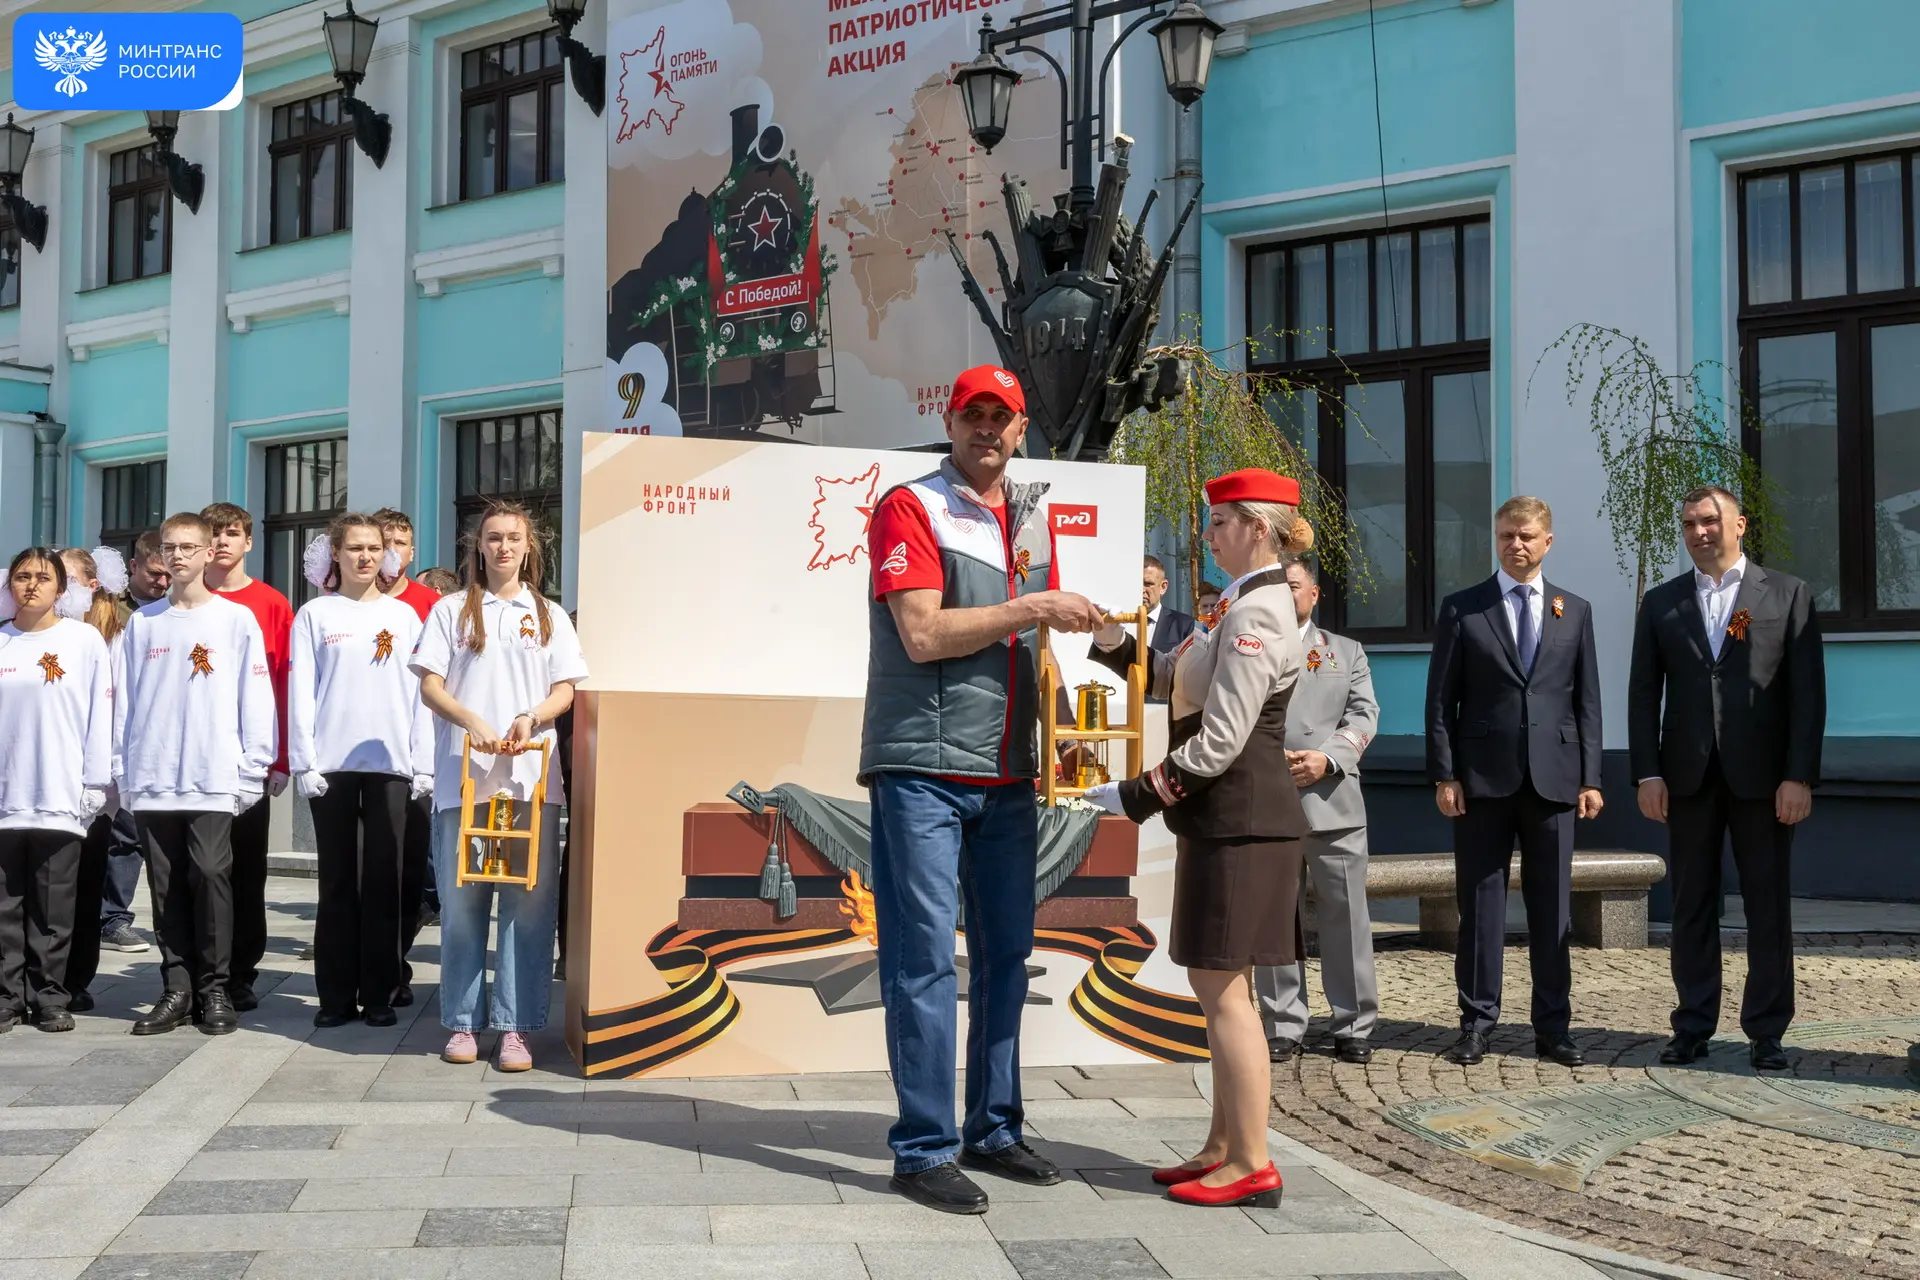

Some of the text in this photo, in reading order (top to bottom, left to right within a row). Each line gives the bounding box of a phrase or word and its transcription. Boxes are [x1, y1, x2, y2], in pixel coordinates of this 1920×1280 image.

[670, 48, 707, 68] ОГОНЬ
[827, 40, 906, 78] АКЦИЯ
[670, 60, 718, 83] ПАМЯТИ
[725, 279, 802, 306] С Победой!
[617, 372, 646, 420] 9
[917, 384, 950, 401] НАРО
[643, 484, 730, 501] НАРОДНЫЙ
[643, 500, 696, 515] ФРОНТ
